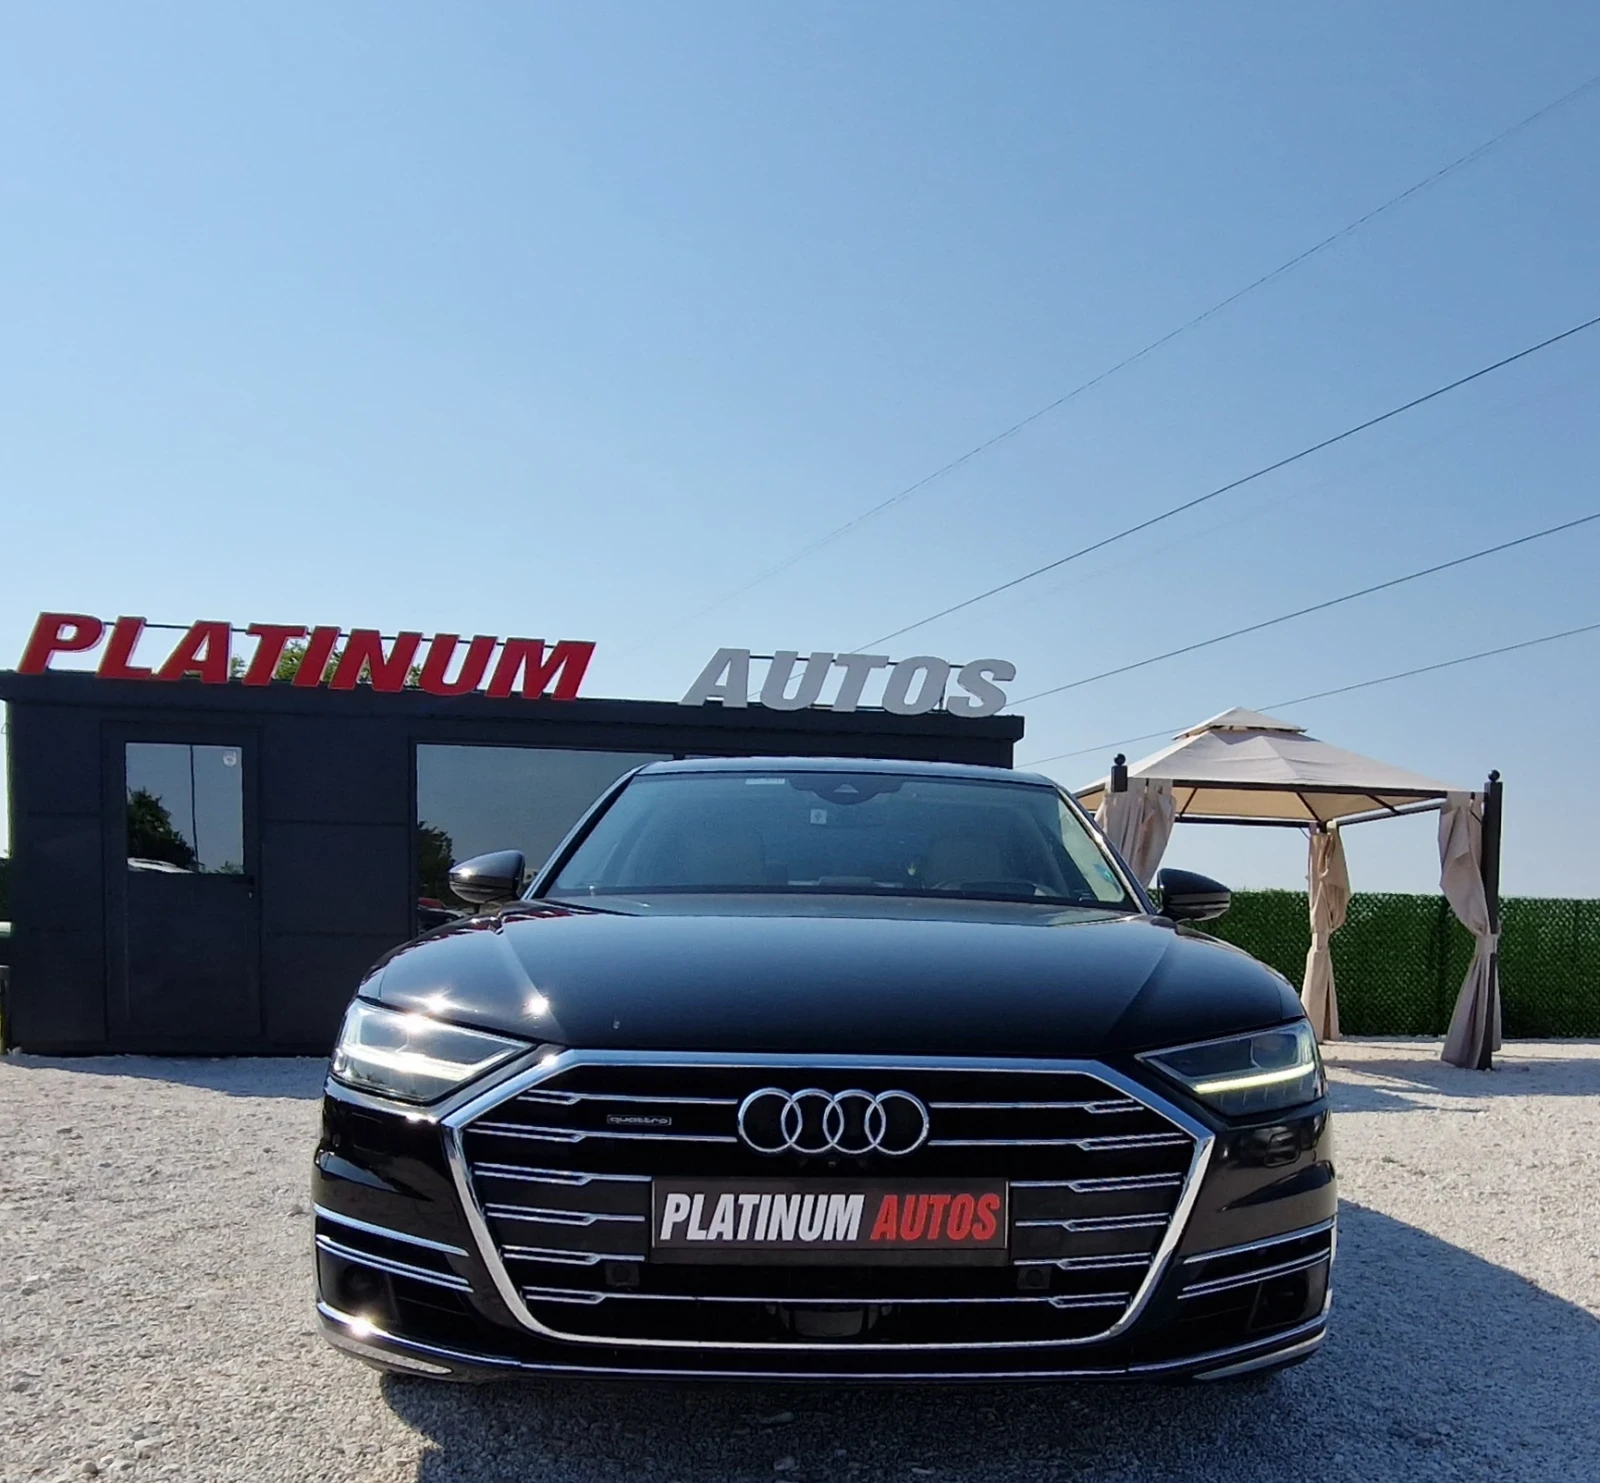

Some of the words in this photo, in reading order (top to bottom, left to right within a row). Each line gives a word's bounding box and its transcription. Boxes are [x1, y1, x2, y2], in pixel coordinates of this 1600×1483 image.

[17, 612, 596, 700] PLATINUM
[679, 648, 1016, 717] AUTOS
[608, 1116, 670, 1125] quattro
[660, 1193, 865, 1241] PLATINUM
[870, 1193, 1000, 1241] AUTOS
